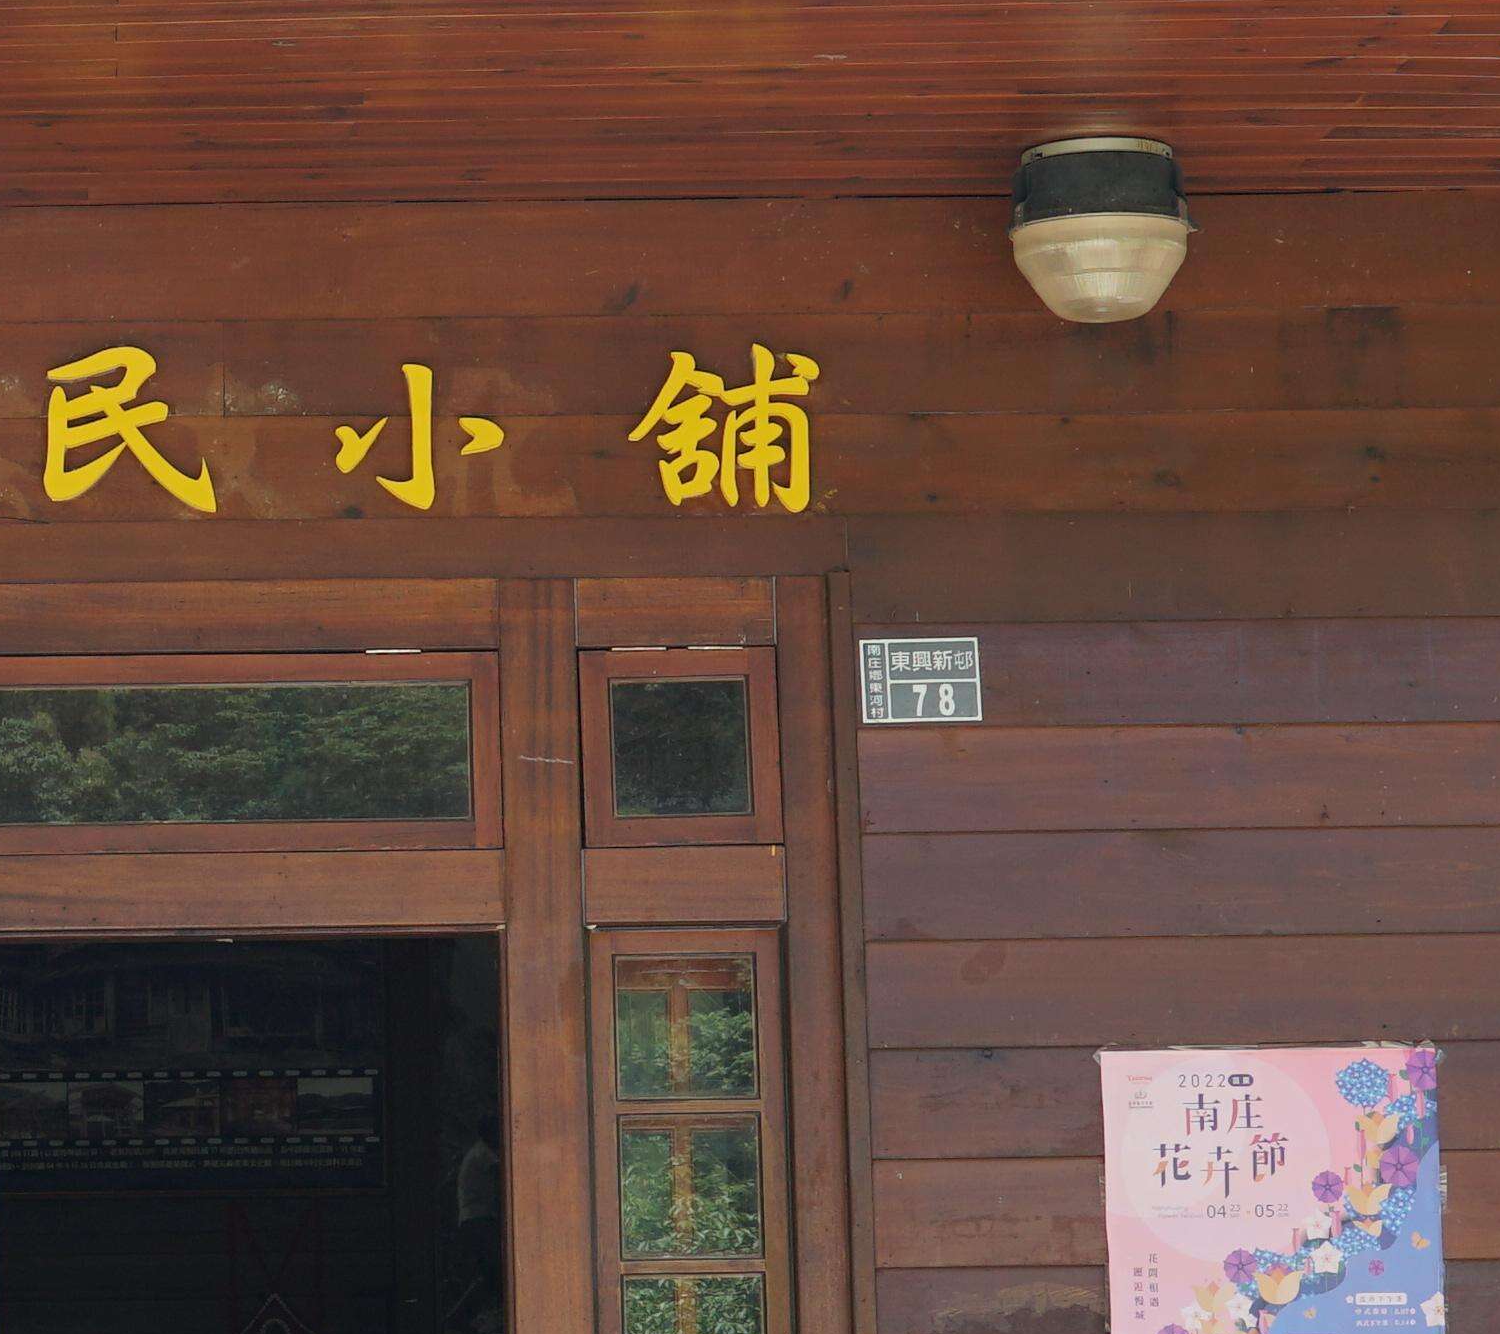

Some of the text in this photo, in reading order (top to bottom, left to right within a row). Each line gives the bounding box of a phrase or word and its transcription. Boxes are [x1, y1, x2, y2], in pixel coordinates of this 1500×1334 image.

[1178, 1074, 1226, 1088] 2022
[1182, 1093, 1265, 1136] 南庄
[1152, 1132, 1289, 1199] 花卉節
[1206, 1205, 1227, 1219] 04
[1254, 1204, 1275, 1218] 05
